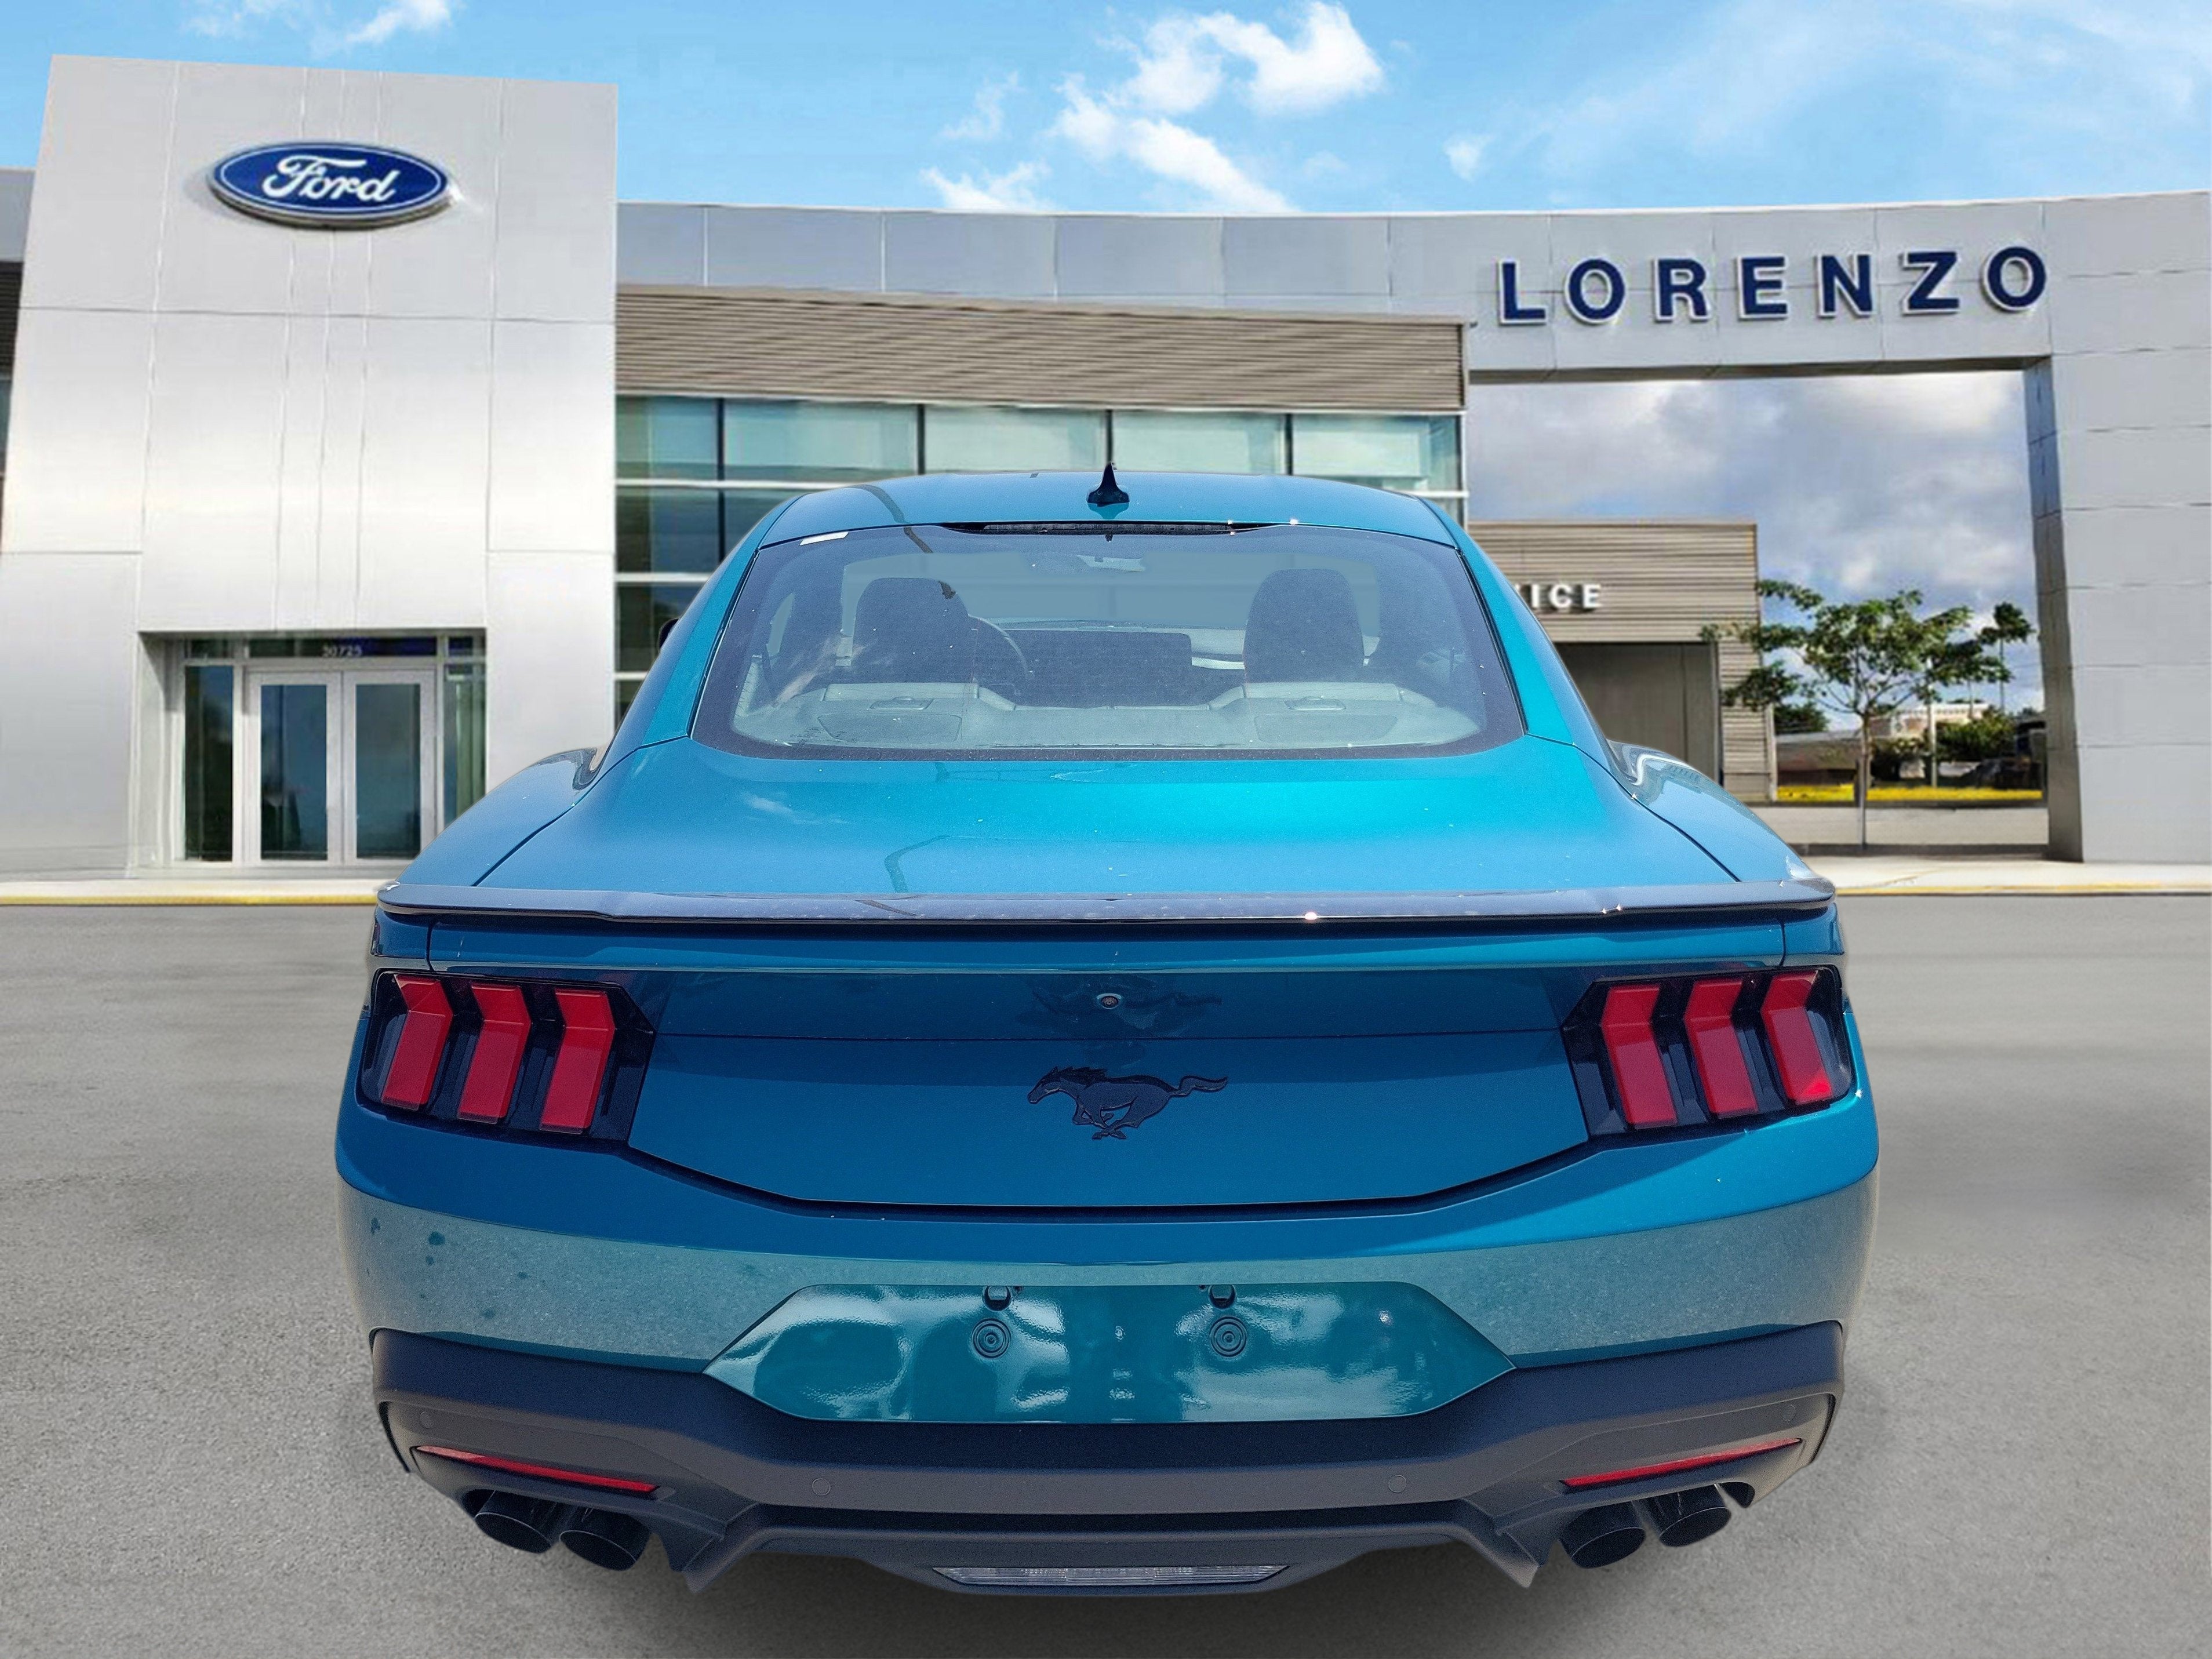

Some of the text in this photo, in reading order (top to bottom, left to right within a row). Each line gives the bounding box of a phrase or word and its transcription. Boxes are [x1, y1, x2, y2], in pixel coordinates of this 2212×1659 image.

[261, 154, 400, 202] Ford
[1498, 246, 2047, 325] LORENZO
[1515, 583, 1603, 609] ICE
